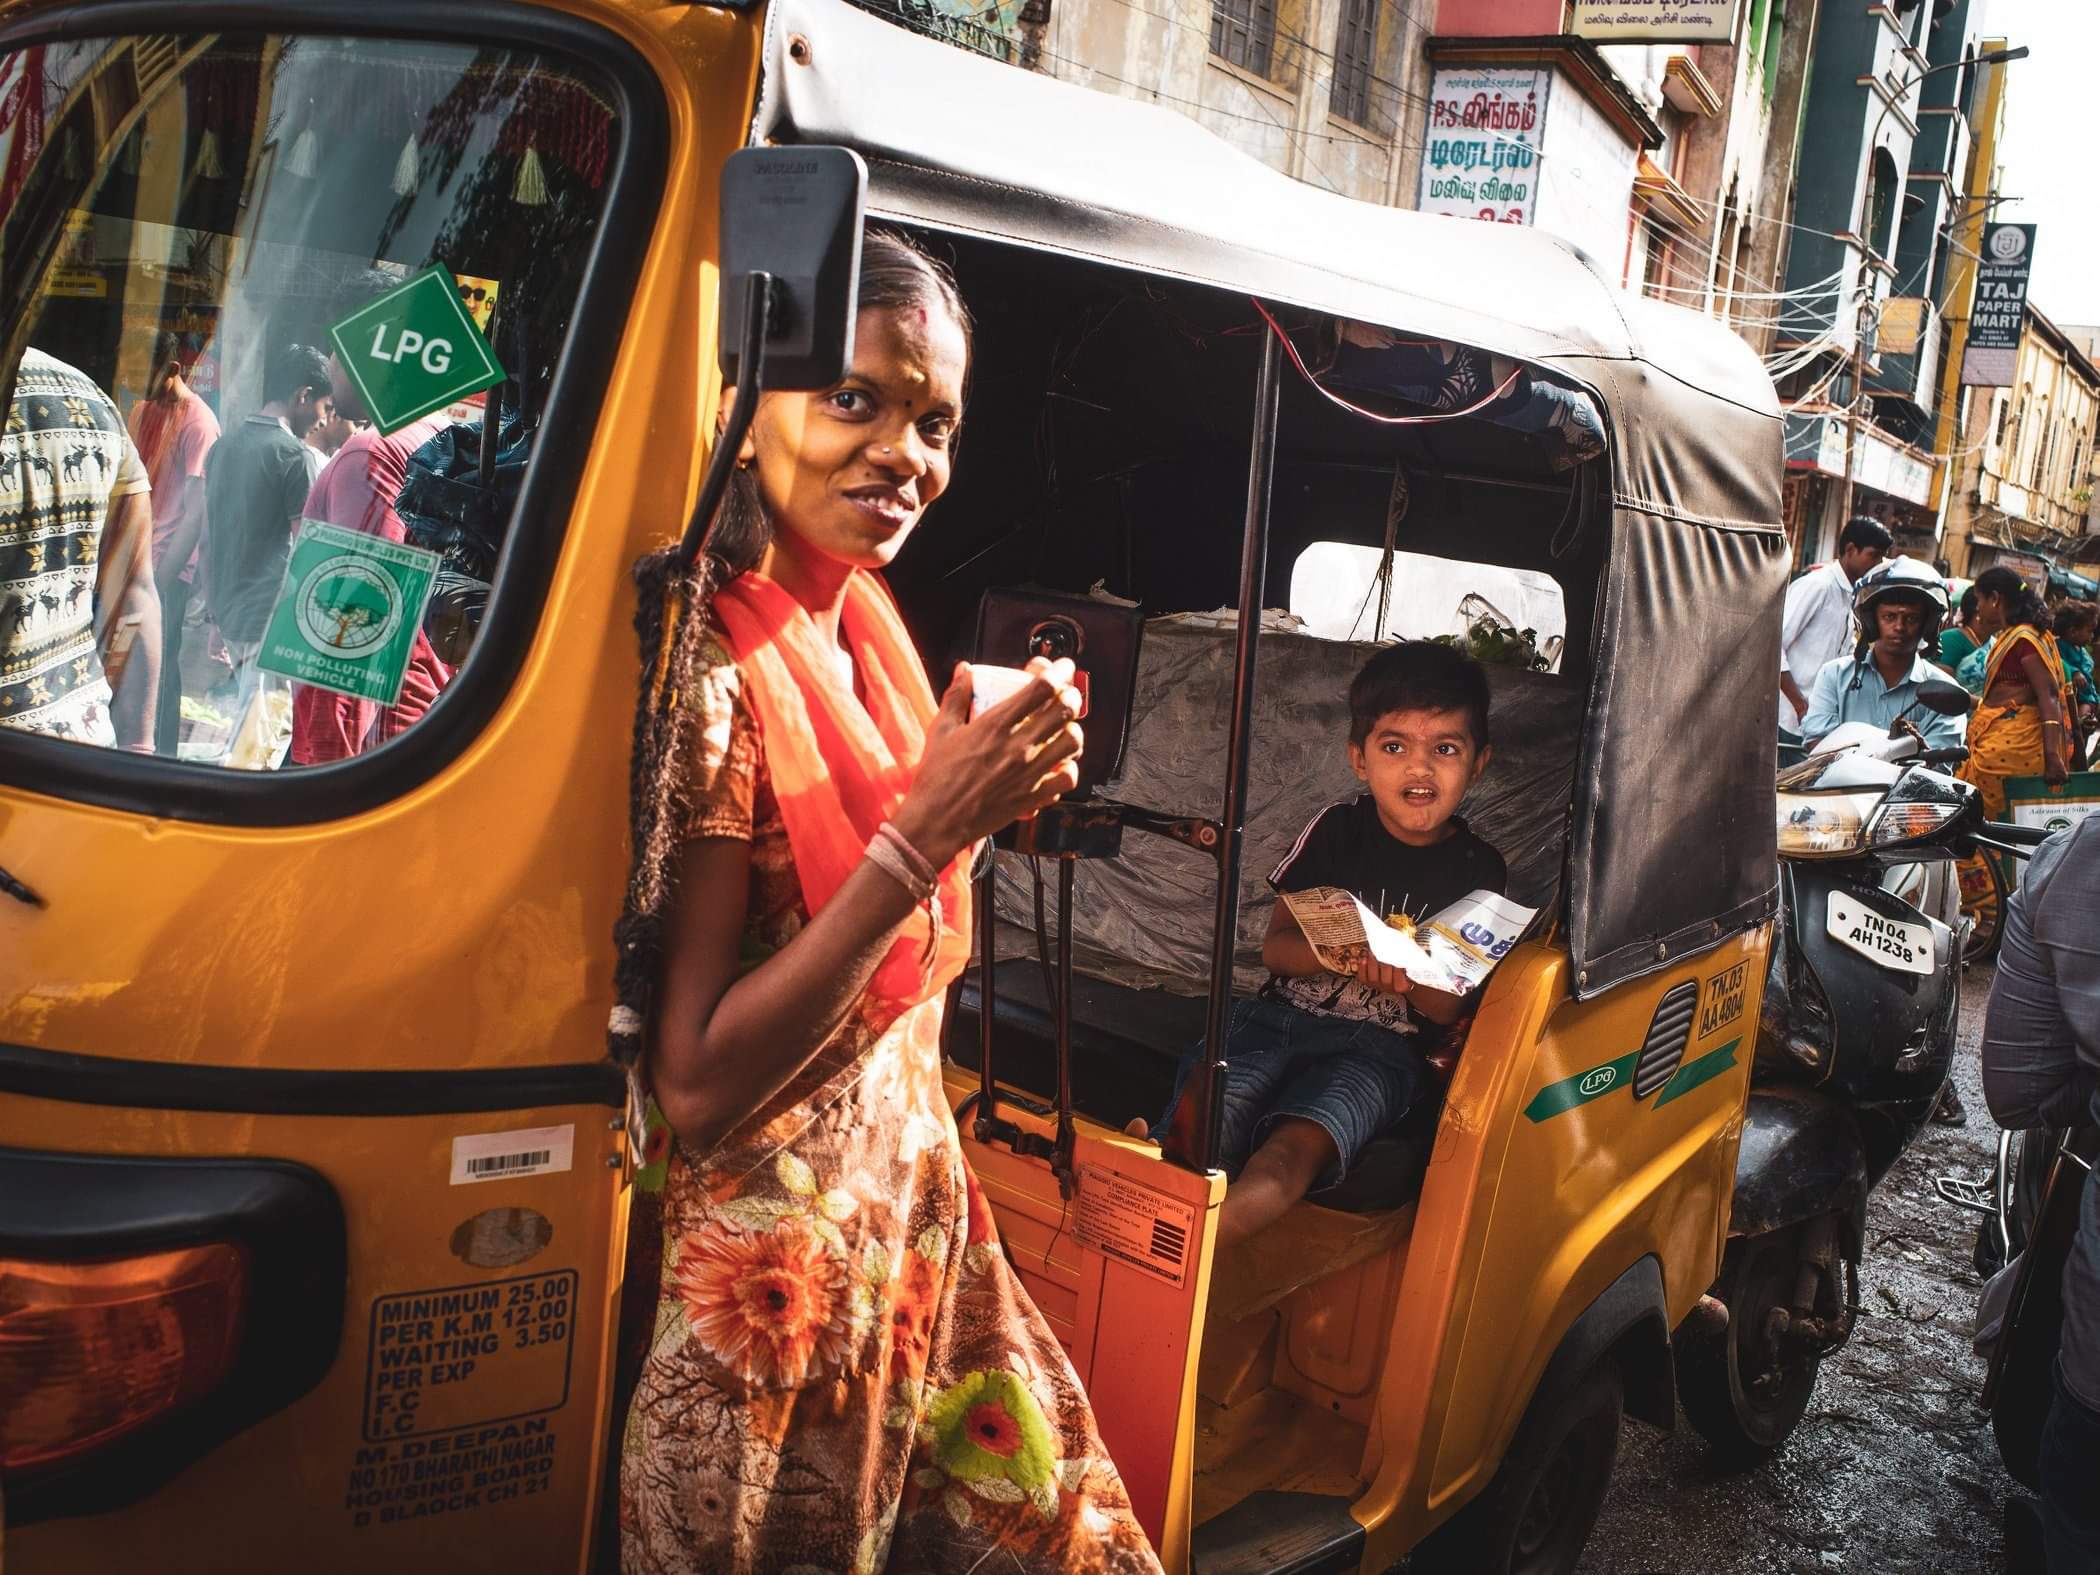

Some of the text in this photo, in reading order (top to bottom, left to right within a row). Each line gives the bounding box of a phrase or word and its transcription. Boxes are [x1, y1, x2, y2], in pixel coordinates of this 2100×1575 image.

[1585, 13, 1614, 26] மலிவு
[1616, 12, 1648, 24] விலை
[1650, 12, 1678, 26] அரிசி
[1479, 177, 1528, 202] விலை
[1980, 282, 2025, 299] TAJ
[1973, 313, 2021, 328] MART
[1976, 301, 2021, 313] PAPER
[370, 324, 453, 374] LPG
[273, 646, 386, 685] NON POLLUTING
[297, 664, 356, 688] VEHICLE
[1863, 913, 1907, 943] TN 04
[1849, 927, 1913, 963] AH 1238
[1712, 966, 1743, 1001] TN.03
[1585, 1070, 1612, 1090] LPG
[1107, 1191, 1140, 1210] COMPLIANCE
[1142, 1205, 1158, 1216] PLATE
[1138, 1192, 1160, 1205] PRIVATE
[1162, 1201, 1183, 1215] LIMITED
[382, 1278, 569, 1322] MINIMUM 25.00
[381, 1301, 567, 1346] PER K.M 12.00
[381, 1322, 566, 1367] WAITING 3.50
[377, 1360, 475, 1391] PER EXP
[376, 1391, 420, 1414] F.C
[373, 1413, 415, 1436] I.C
[356, 1417, 547, 1465] M.DEEPAN
[350, 1434, 557, 1490] NO 170 BHARATHI NAGAR
[346, 1457, 554, 1509] HOUSING BOARD
[486, 1485, 518, 1505] CH
[525, 1475, 550, 1496] 21
